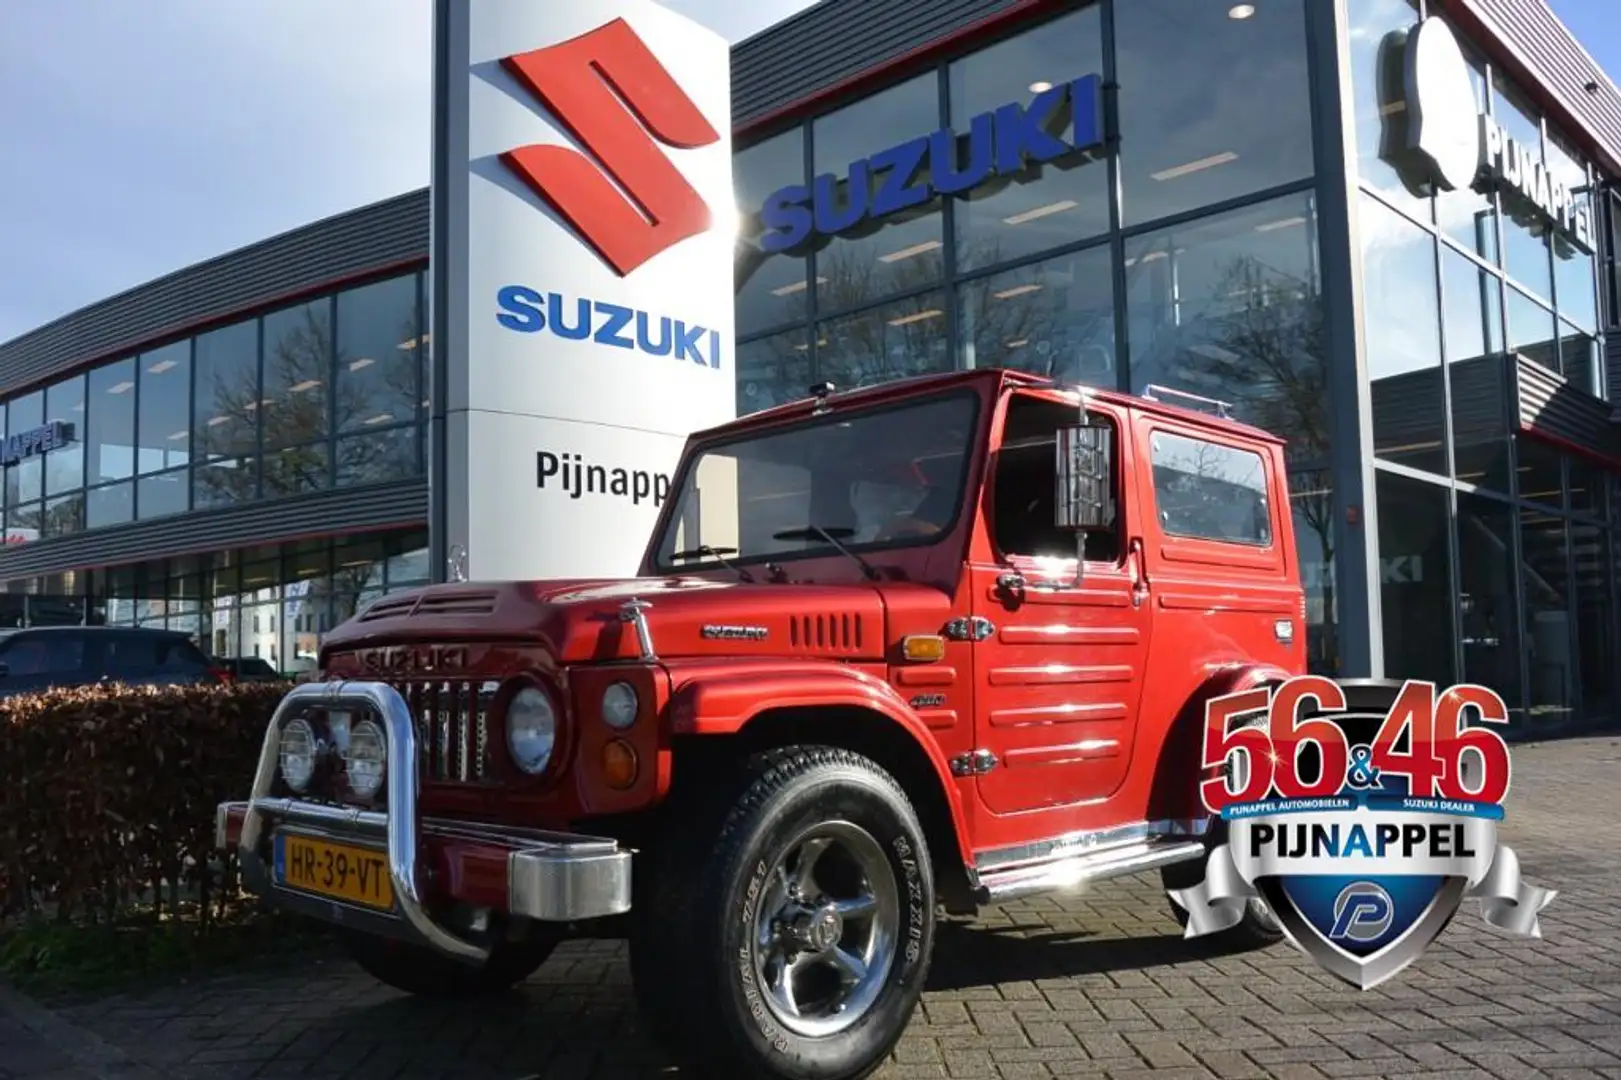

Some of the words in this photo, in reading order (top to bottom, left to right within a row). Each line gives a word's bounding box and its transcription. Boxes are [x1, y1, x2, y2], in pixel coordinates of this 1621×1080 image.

[759, 73, 1104, 253] SUZUKI
[1484, 115, 1598, 253] PIJNAPPEL
[496, 284, 721, 370] SUZUKI
[291, 843, 384, 899] HR-39-VT
